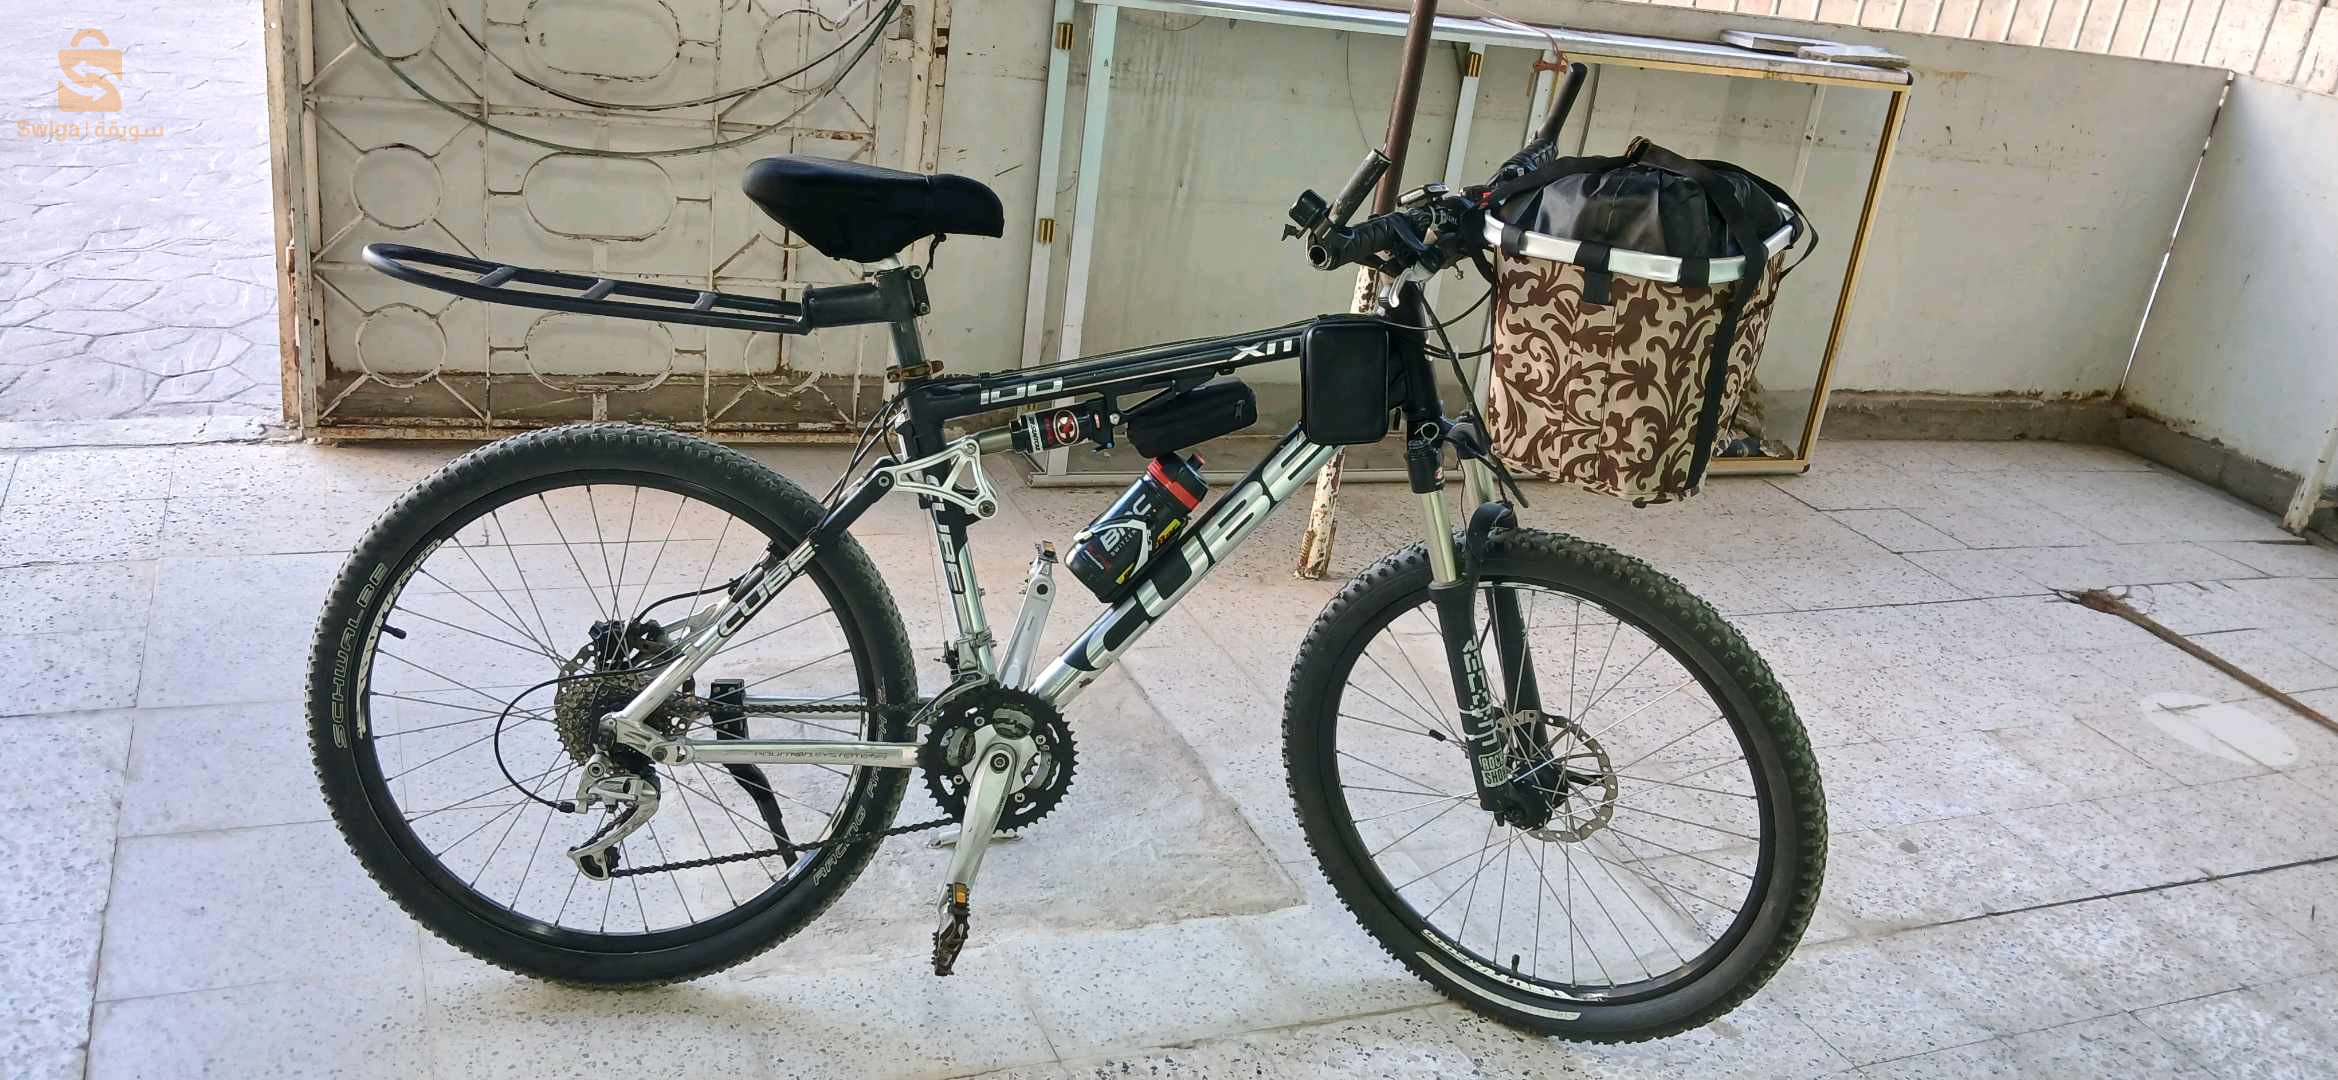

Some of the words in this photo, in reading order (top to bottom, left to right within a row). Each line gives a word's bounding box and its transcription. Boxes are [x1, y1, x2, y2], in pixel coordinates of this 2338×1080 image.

[718, 540, 816, 636] CUBE
[331, 562, 387, 749] SCHWALBE
[1486, 768, 1507, 785] SHO
